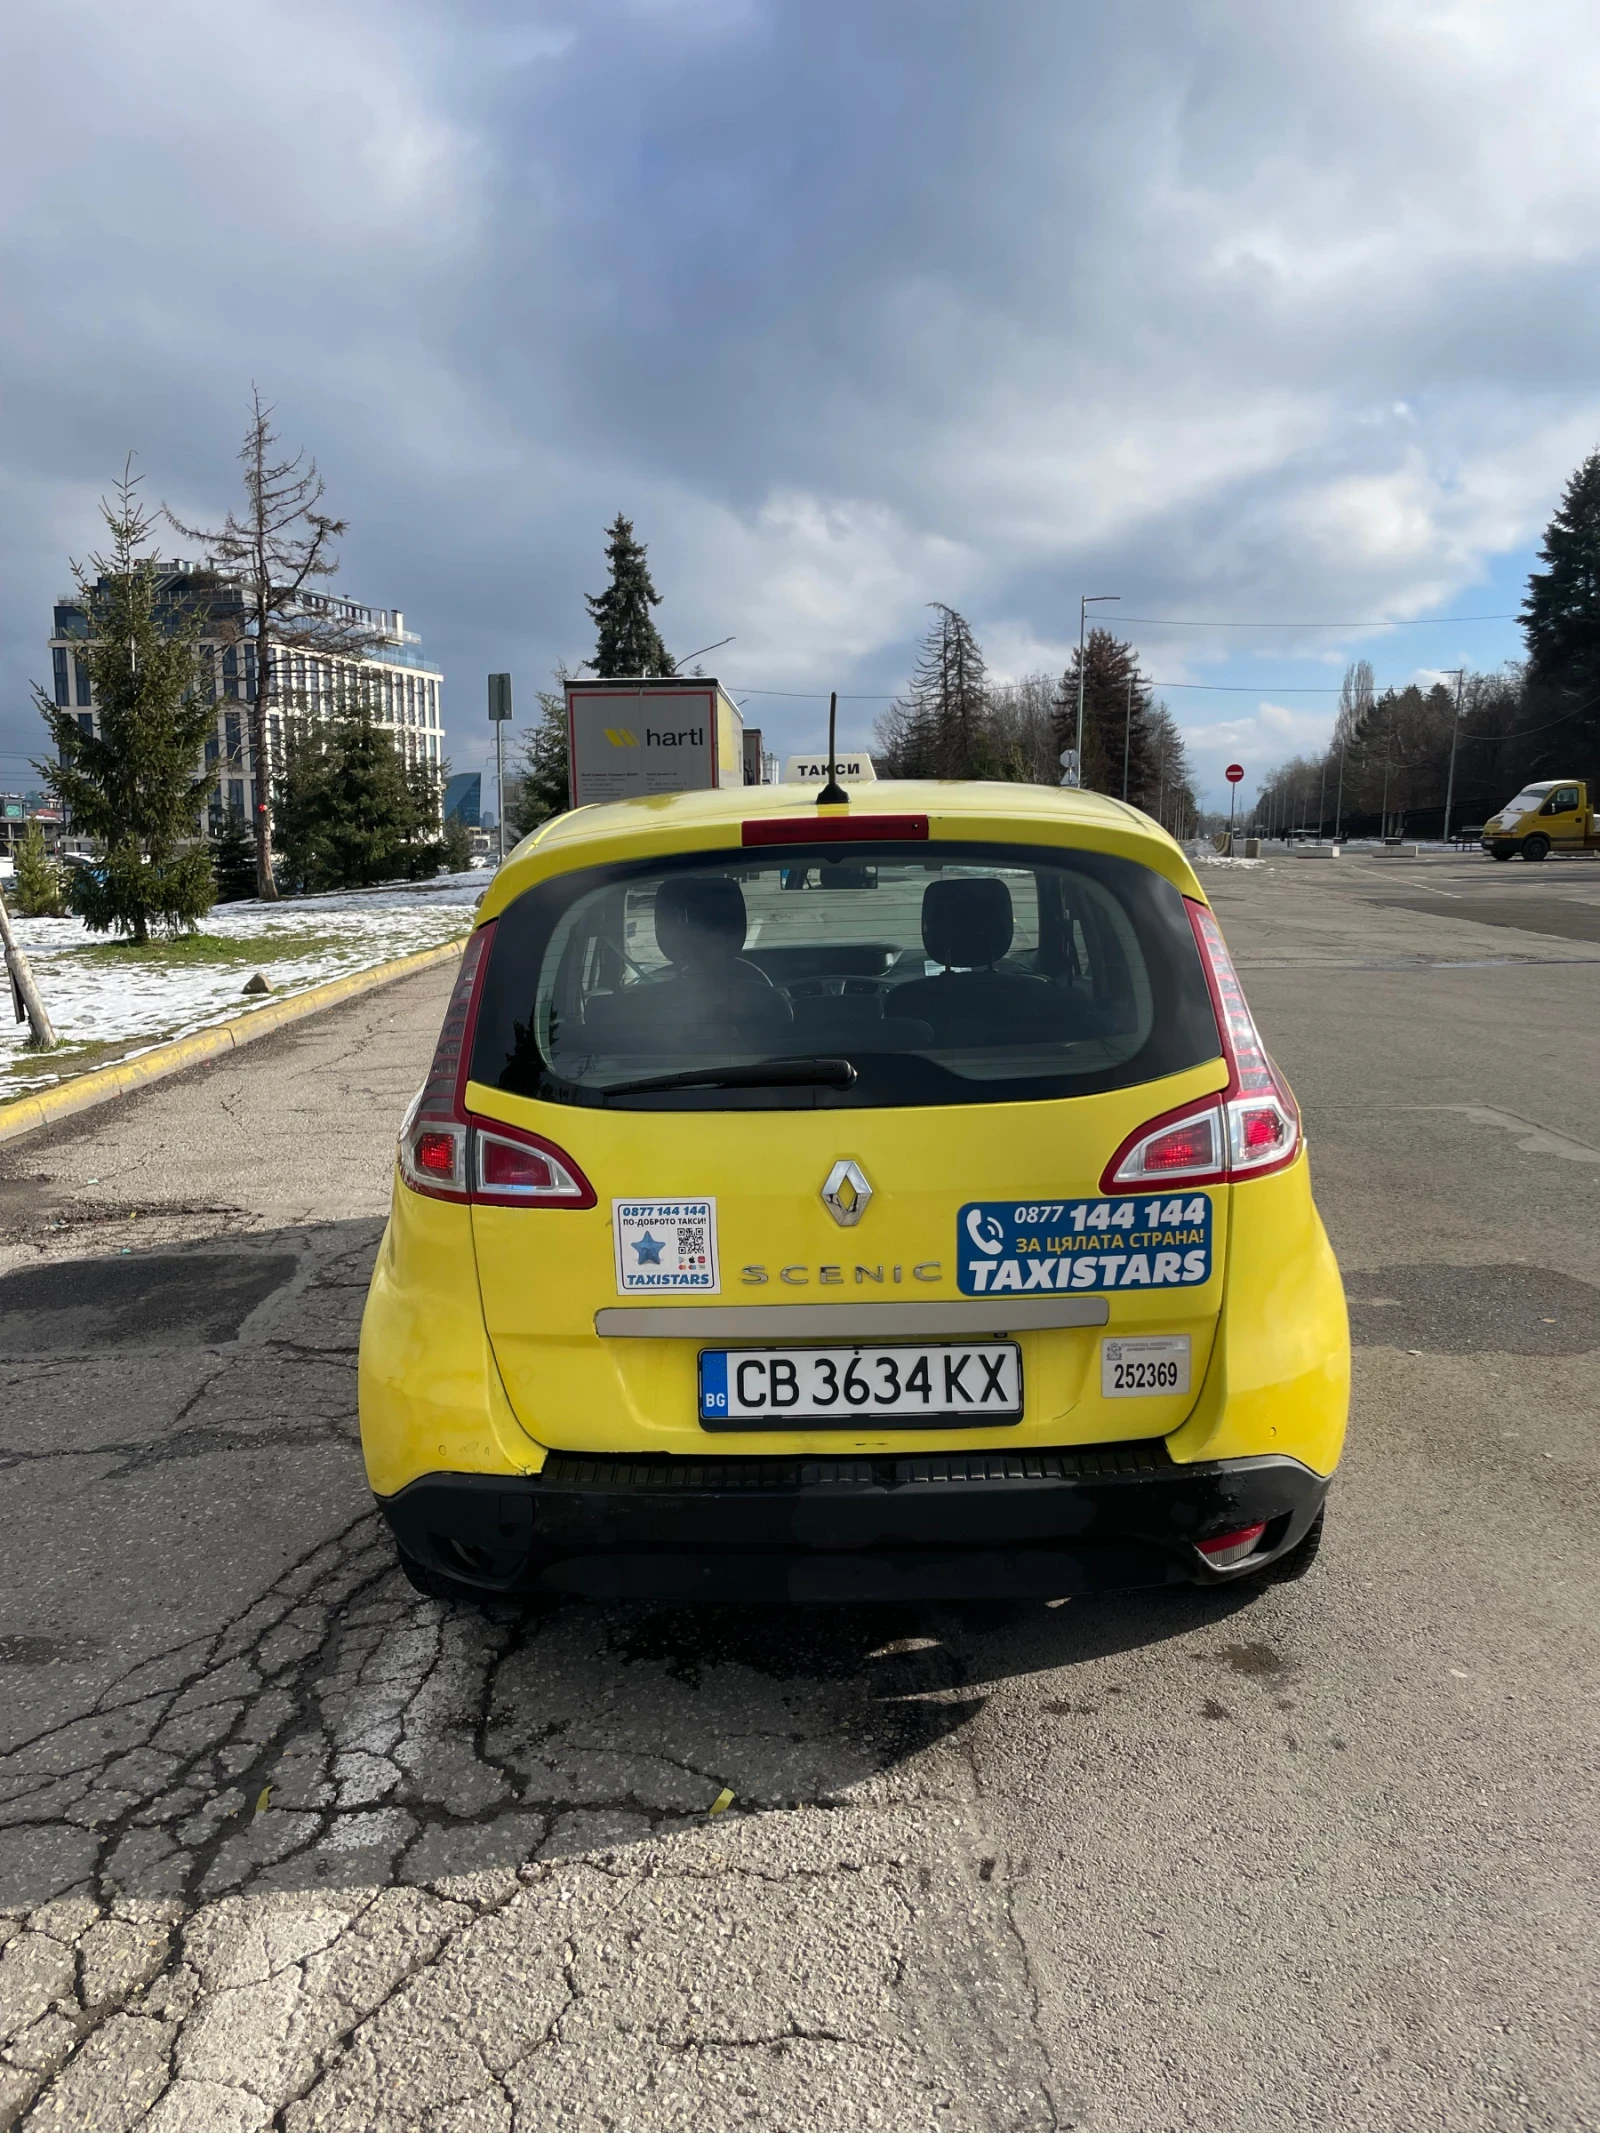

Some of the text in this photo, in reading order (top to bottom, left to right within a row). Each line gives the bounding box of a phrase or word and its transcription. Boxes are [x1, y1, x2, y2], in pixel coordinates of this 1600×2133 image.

[646, 728, 703, 746] hartl
[797, 763, 860, 776] ТАКСИ
[623, 1206, 706, 1216] 0877 144 144
[1014, 1198, 1206, 1232] 0877 144 144
[623, 1218, 676, 1227] ПО-ДОБРОТО
[1015, 1229, 1204, 1255] ЗА ЦЯЛАТА СТРАНА!
[627, 1274, 709, 1285] TAXISTARS
[741, 1261, 942, 1285] SCENIC
[968, 1250, 1206, 1291] TAXISTARS
[737, 1353, 1009, 1408] CB 3634 KX
[1114, 1362, 1178, 1389] 252369
[705, 1393, 726, 1408] BG
